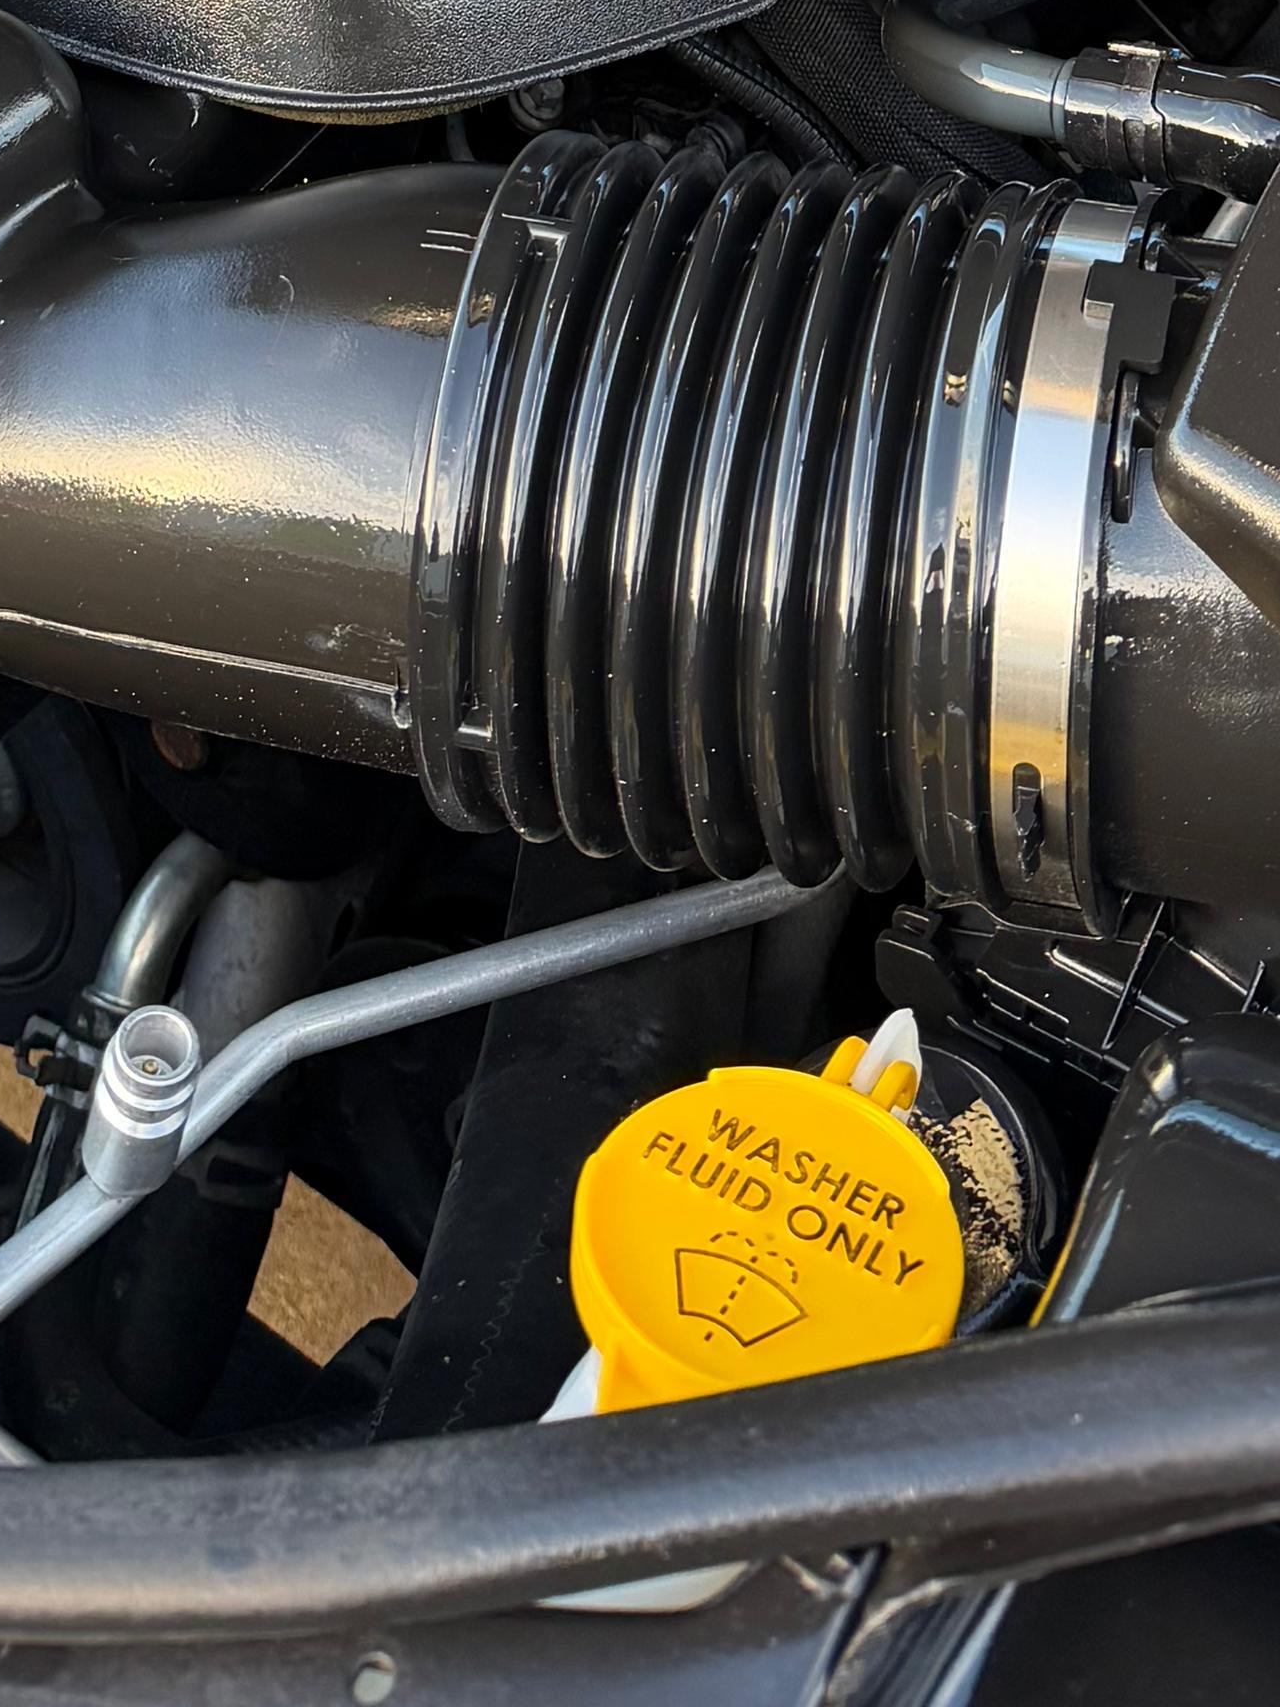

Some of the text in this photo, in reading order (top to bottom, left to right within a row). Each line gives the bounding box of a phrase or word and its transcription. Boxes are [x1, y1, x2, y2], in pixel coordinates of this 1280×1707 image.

[642, 1131, 926, 1289] FLUID ONLY
[707, 1107, 907, 1232] WASHER
